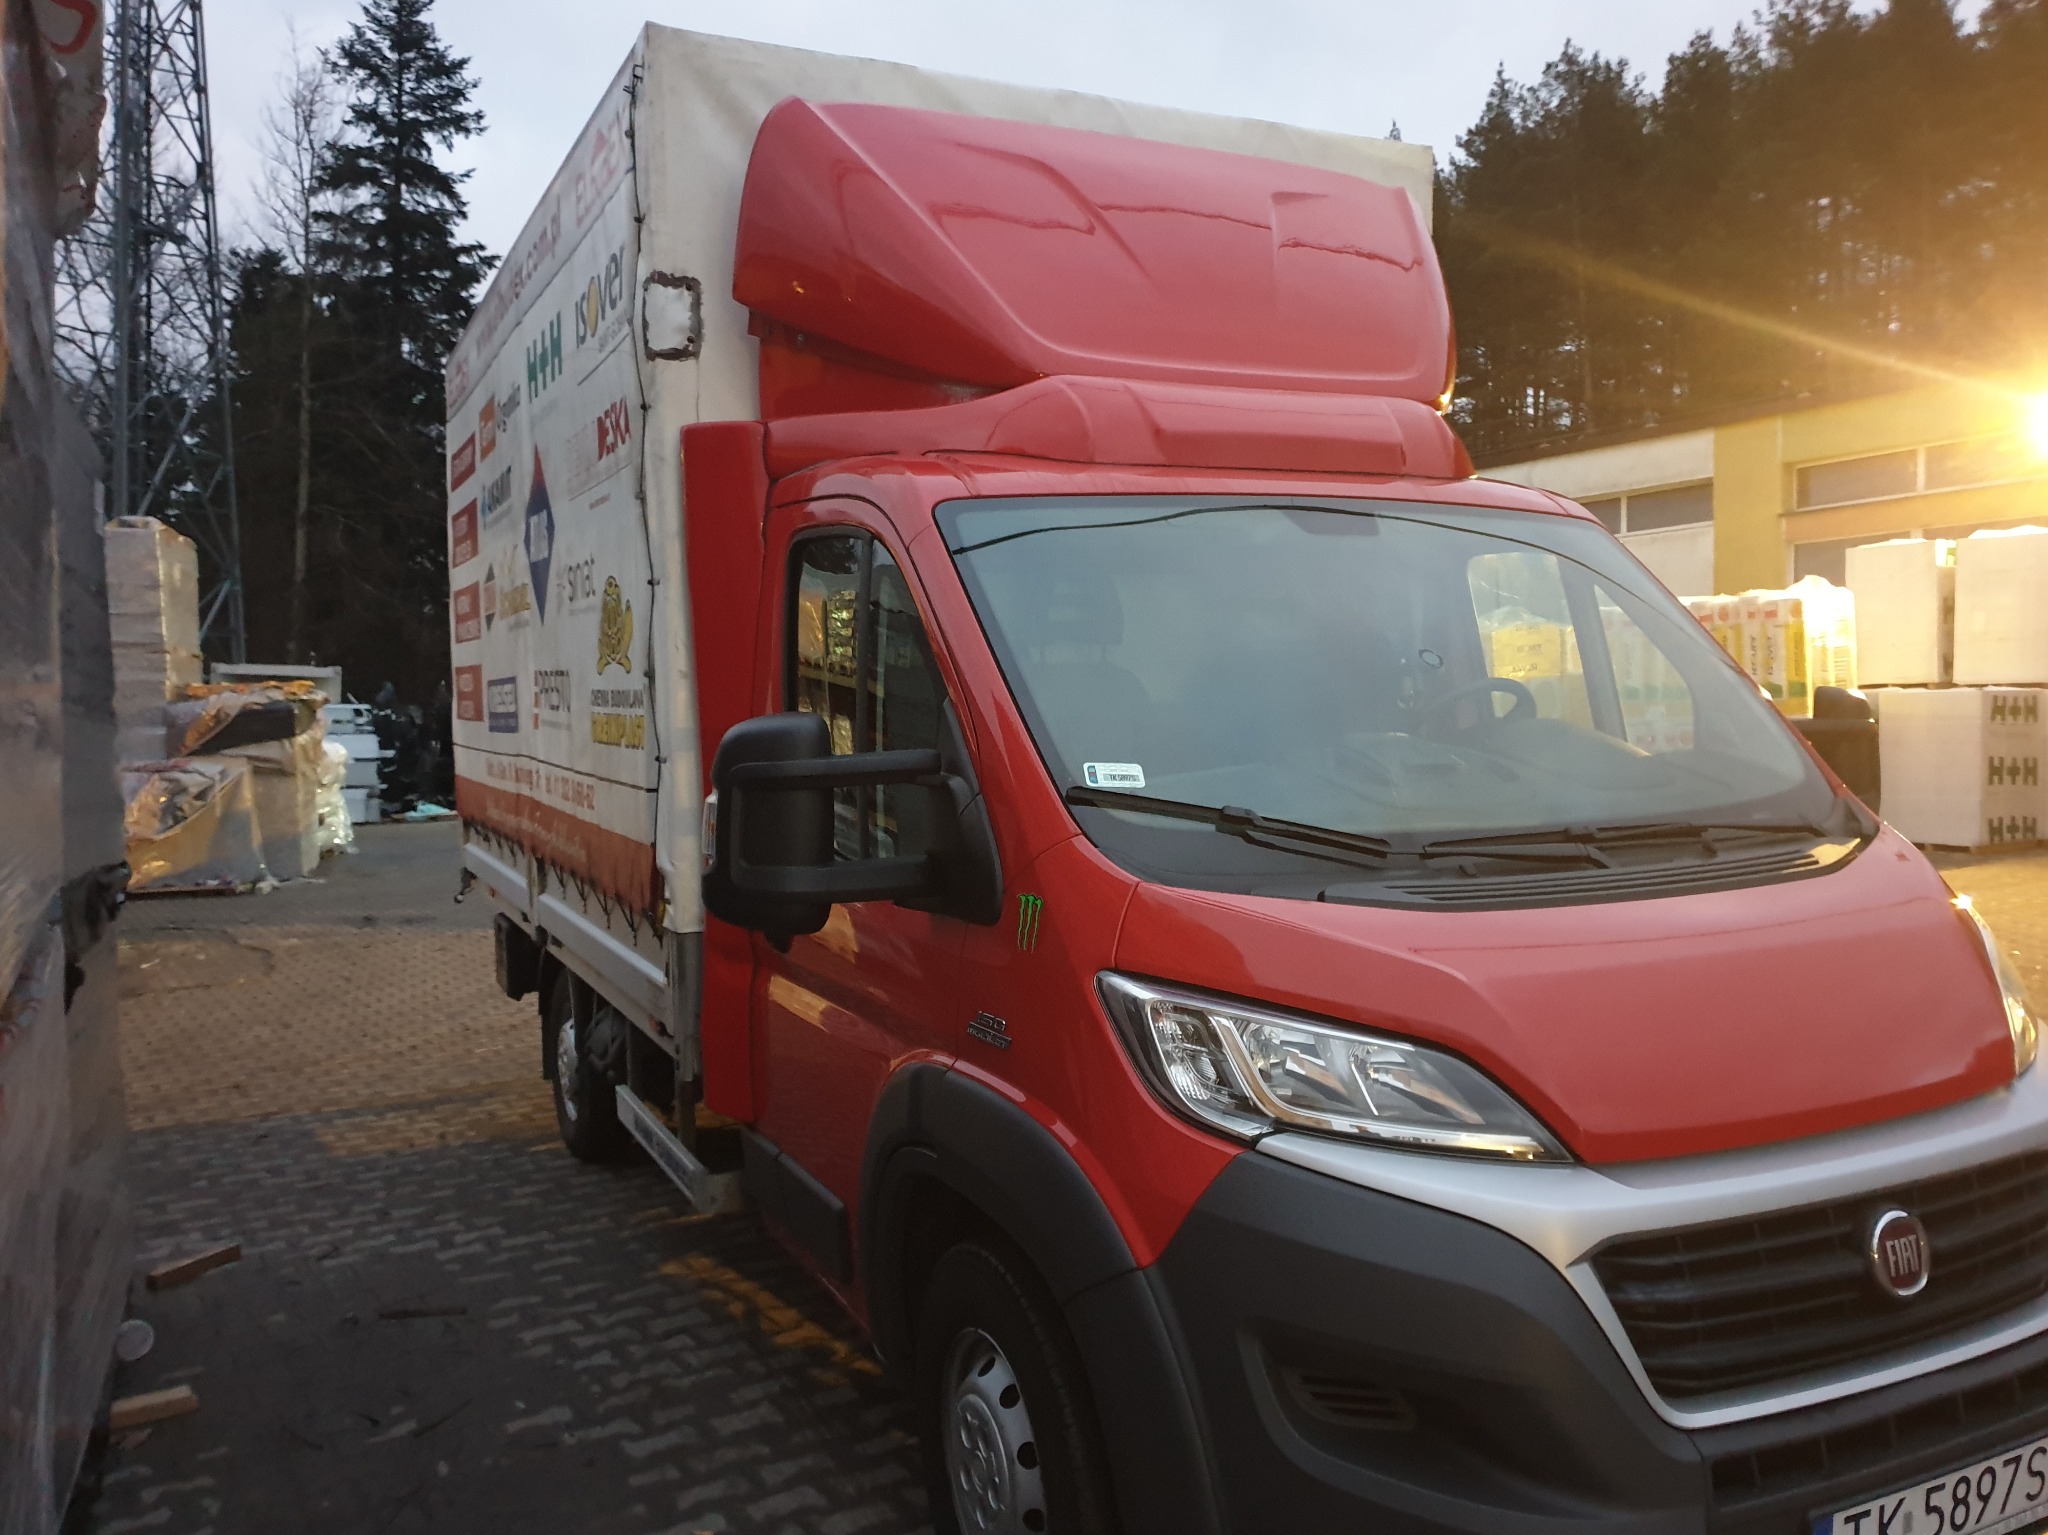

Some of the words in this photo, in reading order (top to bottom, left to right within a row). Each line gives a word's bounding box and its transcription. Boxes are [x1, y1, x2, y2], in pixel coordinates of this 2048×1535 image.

[526, 311, 563, 404] H+H
[597, 395, 632, 461] DESKA
[1990, 695, 2038, 722] H+H
[1988, 756, 2038, 786] H+H
[1988, 816, 2037, 842] H+H
[1886, 1234, 1920, 1277] FIAT
[1924, 1446, 2048, 1535] 5897S
